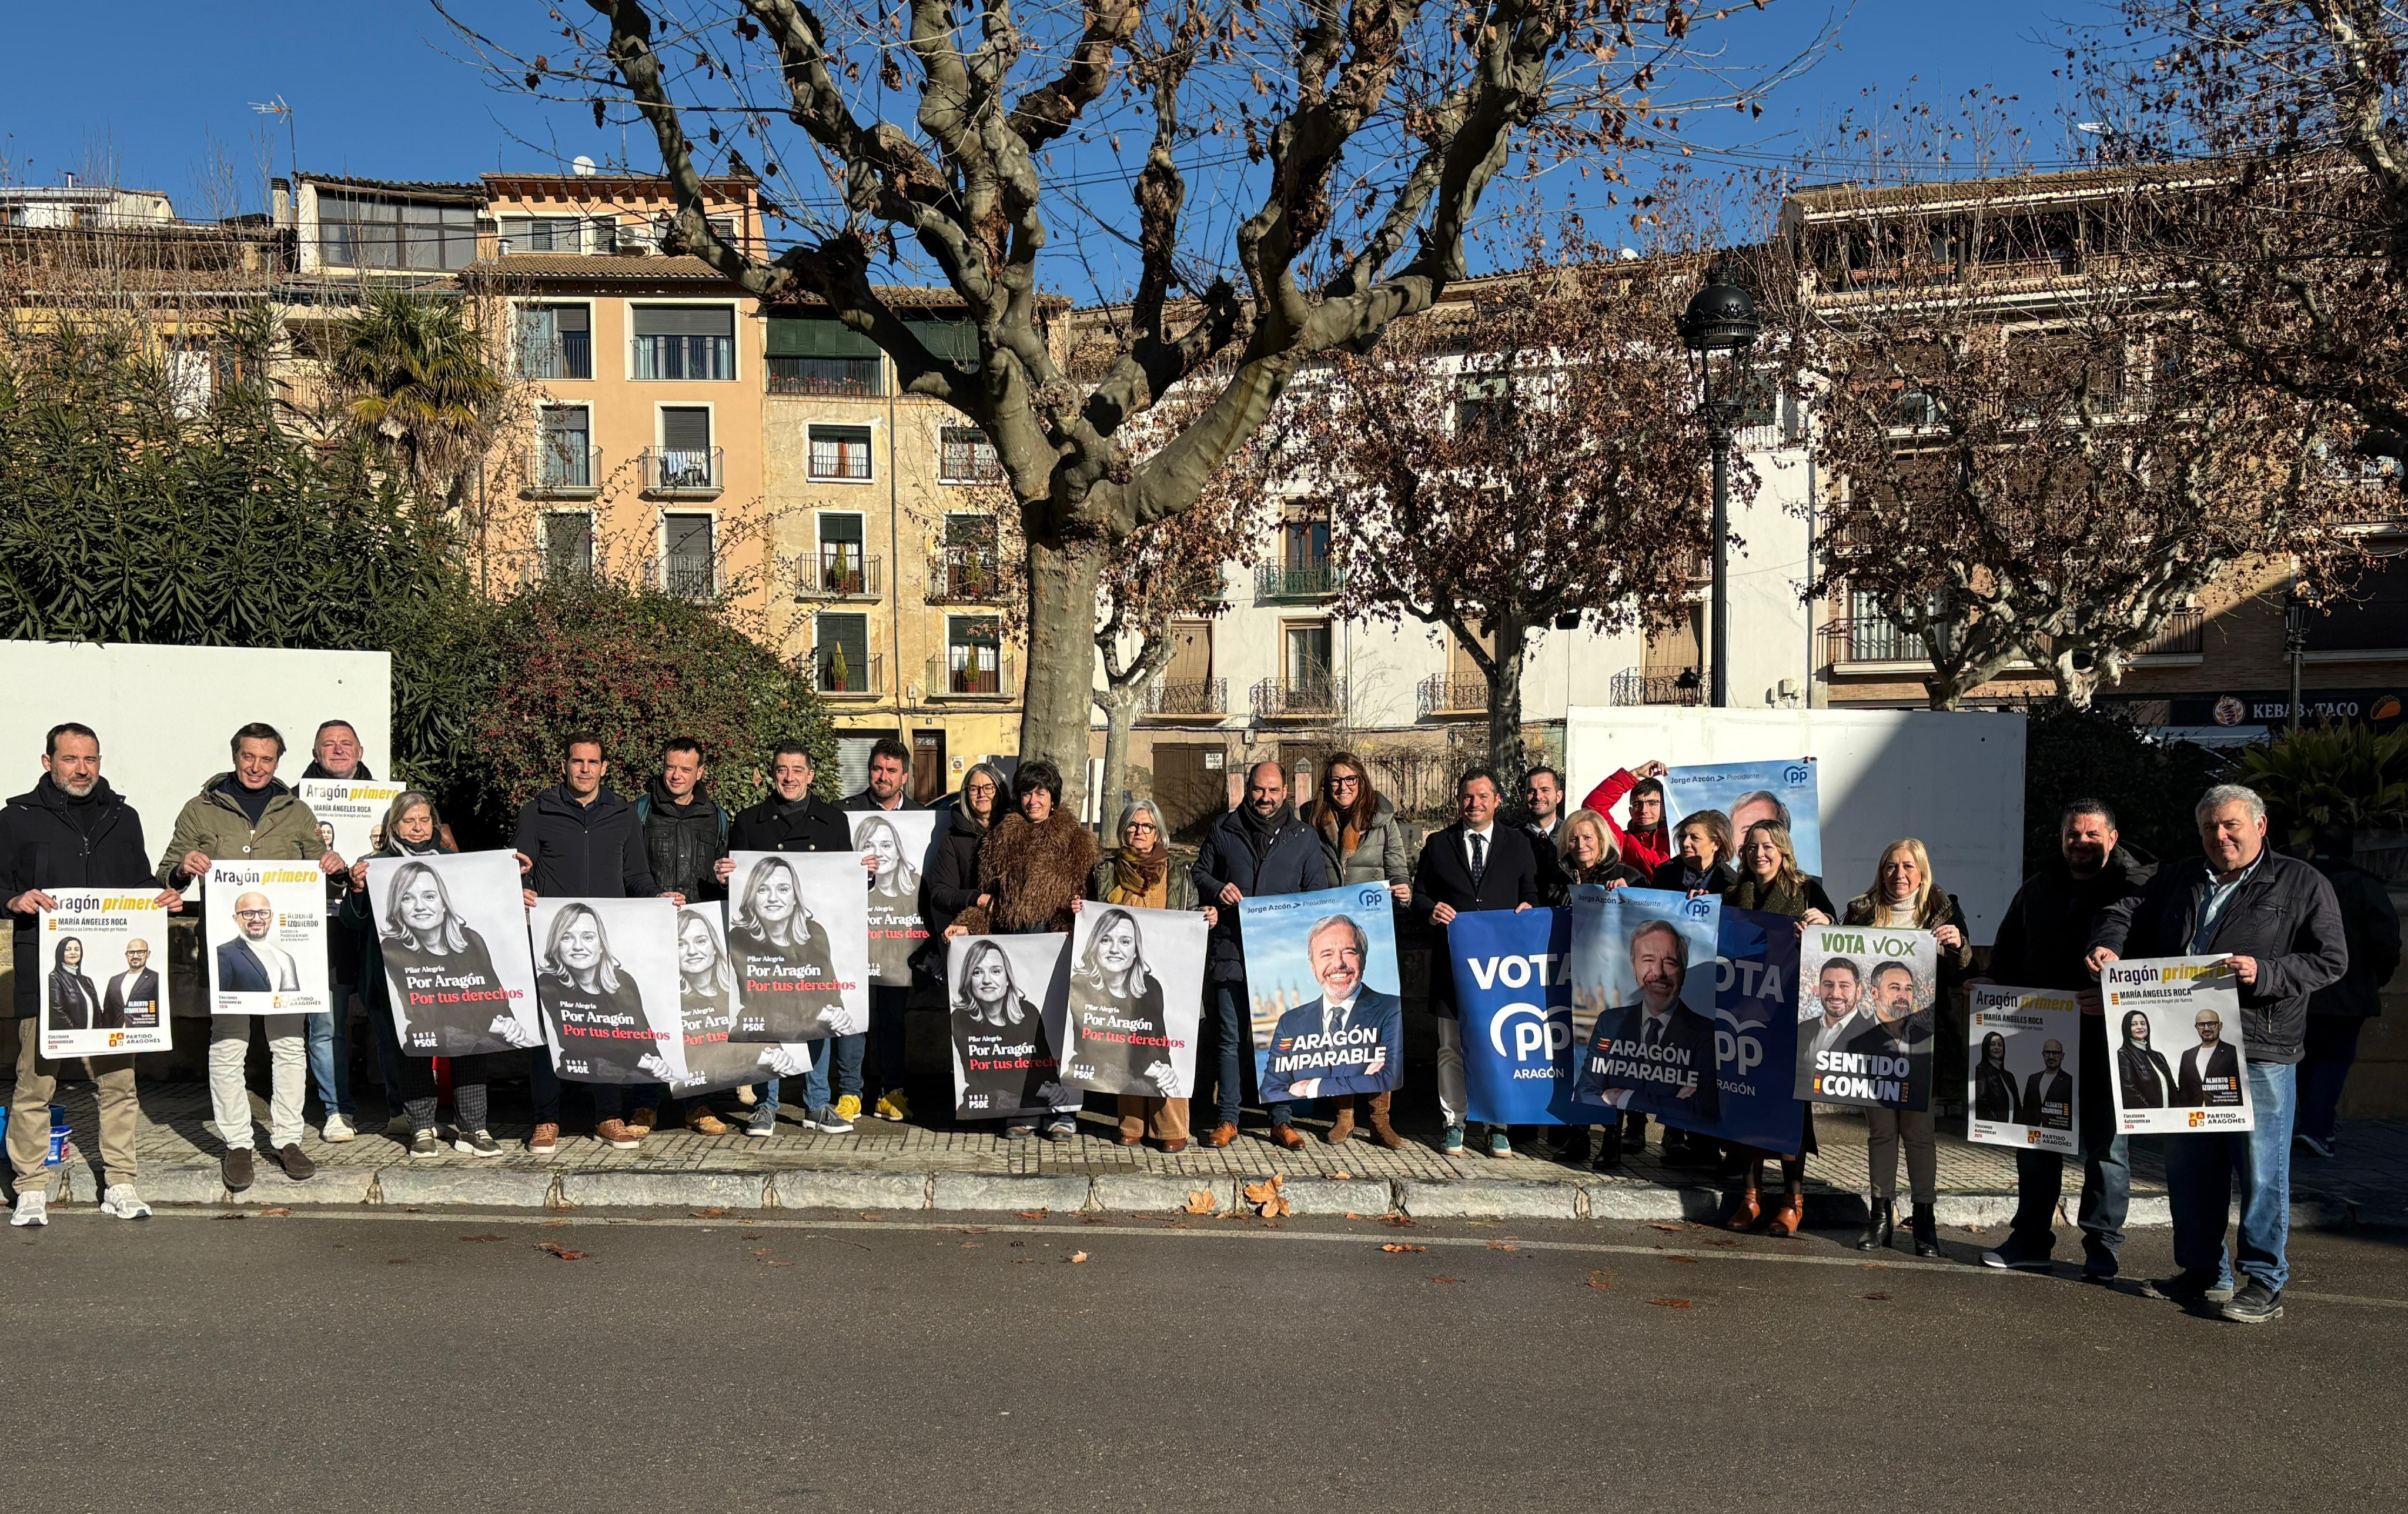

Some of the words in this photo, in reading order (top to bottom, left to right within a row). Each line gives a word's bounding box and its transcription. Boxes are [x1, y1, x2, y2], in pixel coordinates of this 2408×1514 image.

[2315, 703, 2359, 718] TACO
[306, 784, 347, 801] Aragón
[333, 804, 356, 812] ÁNGELES
[215, 868, 259, 886] Aragón
[262, 868, 318, 885] primero
[1303, 898, 1335, 907] Presidente
[1578, 894, 1594, 903] Jorge
[1595, 895, 1617, 904] Azcón
[1628, 899, 1661, 907] Presidente
[58, 917, 79, 925] MARÍA
[81, 916, 109, 925] ÁNGELES
[885, 928, 903, 939] tus
[1821, 933, 1865, 954] VOTA
[1872, 936, 1917, 957] VOX
[422, 965, 445, 974] Alegría
[747, 965, 770, 977] Por
[772, 964, 821, 979] Aragón
[2109, 965, 2158, 985] Aragón
[2162, 963, 2226, 984] primero
[406, 976, 432, 989] Por
[435, 972, 486, 989] Aragón
[747, 980, 771, 992] Por
[772, 980, 794, 991] tus
[795, 978, 856, 991] derechos
[1715, 956, 1784, 1003] OTA
[409, 992, 435, 1005] Por
[437, 991, 459, 1003] tus
[461, 987, 523, 1002] derechos
[2119, 990, 2142, 999] MARÍA
[2143, 988, 2172, 998] ÁNGELES
[2173, 988, 2192, 996] ROCA
[575, 1001, 597, 1010] Alegría
[1976, 991, 2017, 1010] Aragón
[2019, 995, 2074, 1012] primero
[693, 1007, 715, 1015] Alegría
[1099, 1005, 1119, 1014] Alegría
[561, 1010, 584, 1022] Por
[587, 1012, 634, 1027] Aragón
[1083, 1012, 1106, 1025] Por
[1107, 1015, 1152, 1032] Aragón
[1984, 1012, 2001, 1022] MARÍA
[2002, 1014, 2027, 1024] ÁNGELES
[2028, 1017, 2044, 1025] ROCA
[563, 1024, 586, 1037] Por
[588, 1027, 610, 1038] tus
[612, 1028, 670, 1041] derechos
[743, 1023, 765, 1031] PSOE
[414, 1038, 438, 1048] PSOE
[683, 1034, 704, 1046] Por
[706, 1032, 728, 1042] tus
[1082, 1027, 1104, 1040] Por
[1106, 1031, 1126, 1043] tus
[1128, 1032, 1185, 1048] derechos
[1292, 1024, 1377, 1052] ARAGÓN
[968, 1044, 990, 1056] Por
[992, 1042, 1036, 1057] Aragón
[1609, 1040, 1691, 1065] ARAGÓN
[970, 1059, 991, 1071] Por
[993, 1059, 1012, 1069] tus
[1014, 1056, 1060, 1068] derech
[1275, 1047, 1386, 1073] IMPARABLE
[1815, 1050, 1910, 1078] SENTIDO
[567, 1065, 589, 1074] PSOE
[1073, 1070, 1095, 1080] PSOE
[1513, 1066, 1564, 1079] ARAGÓN
[1591, 1057, 1699, 1087] IMPARABLE
[1717, 1079, 1755, 1097] RAGÓN
[1822, 1075, 1900, 1102] COMÚN
[969, 1100, 989, 1108] PSOE
